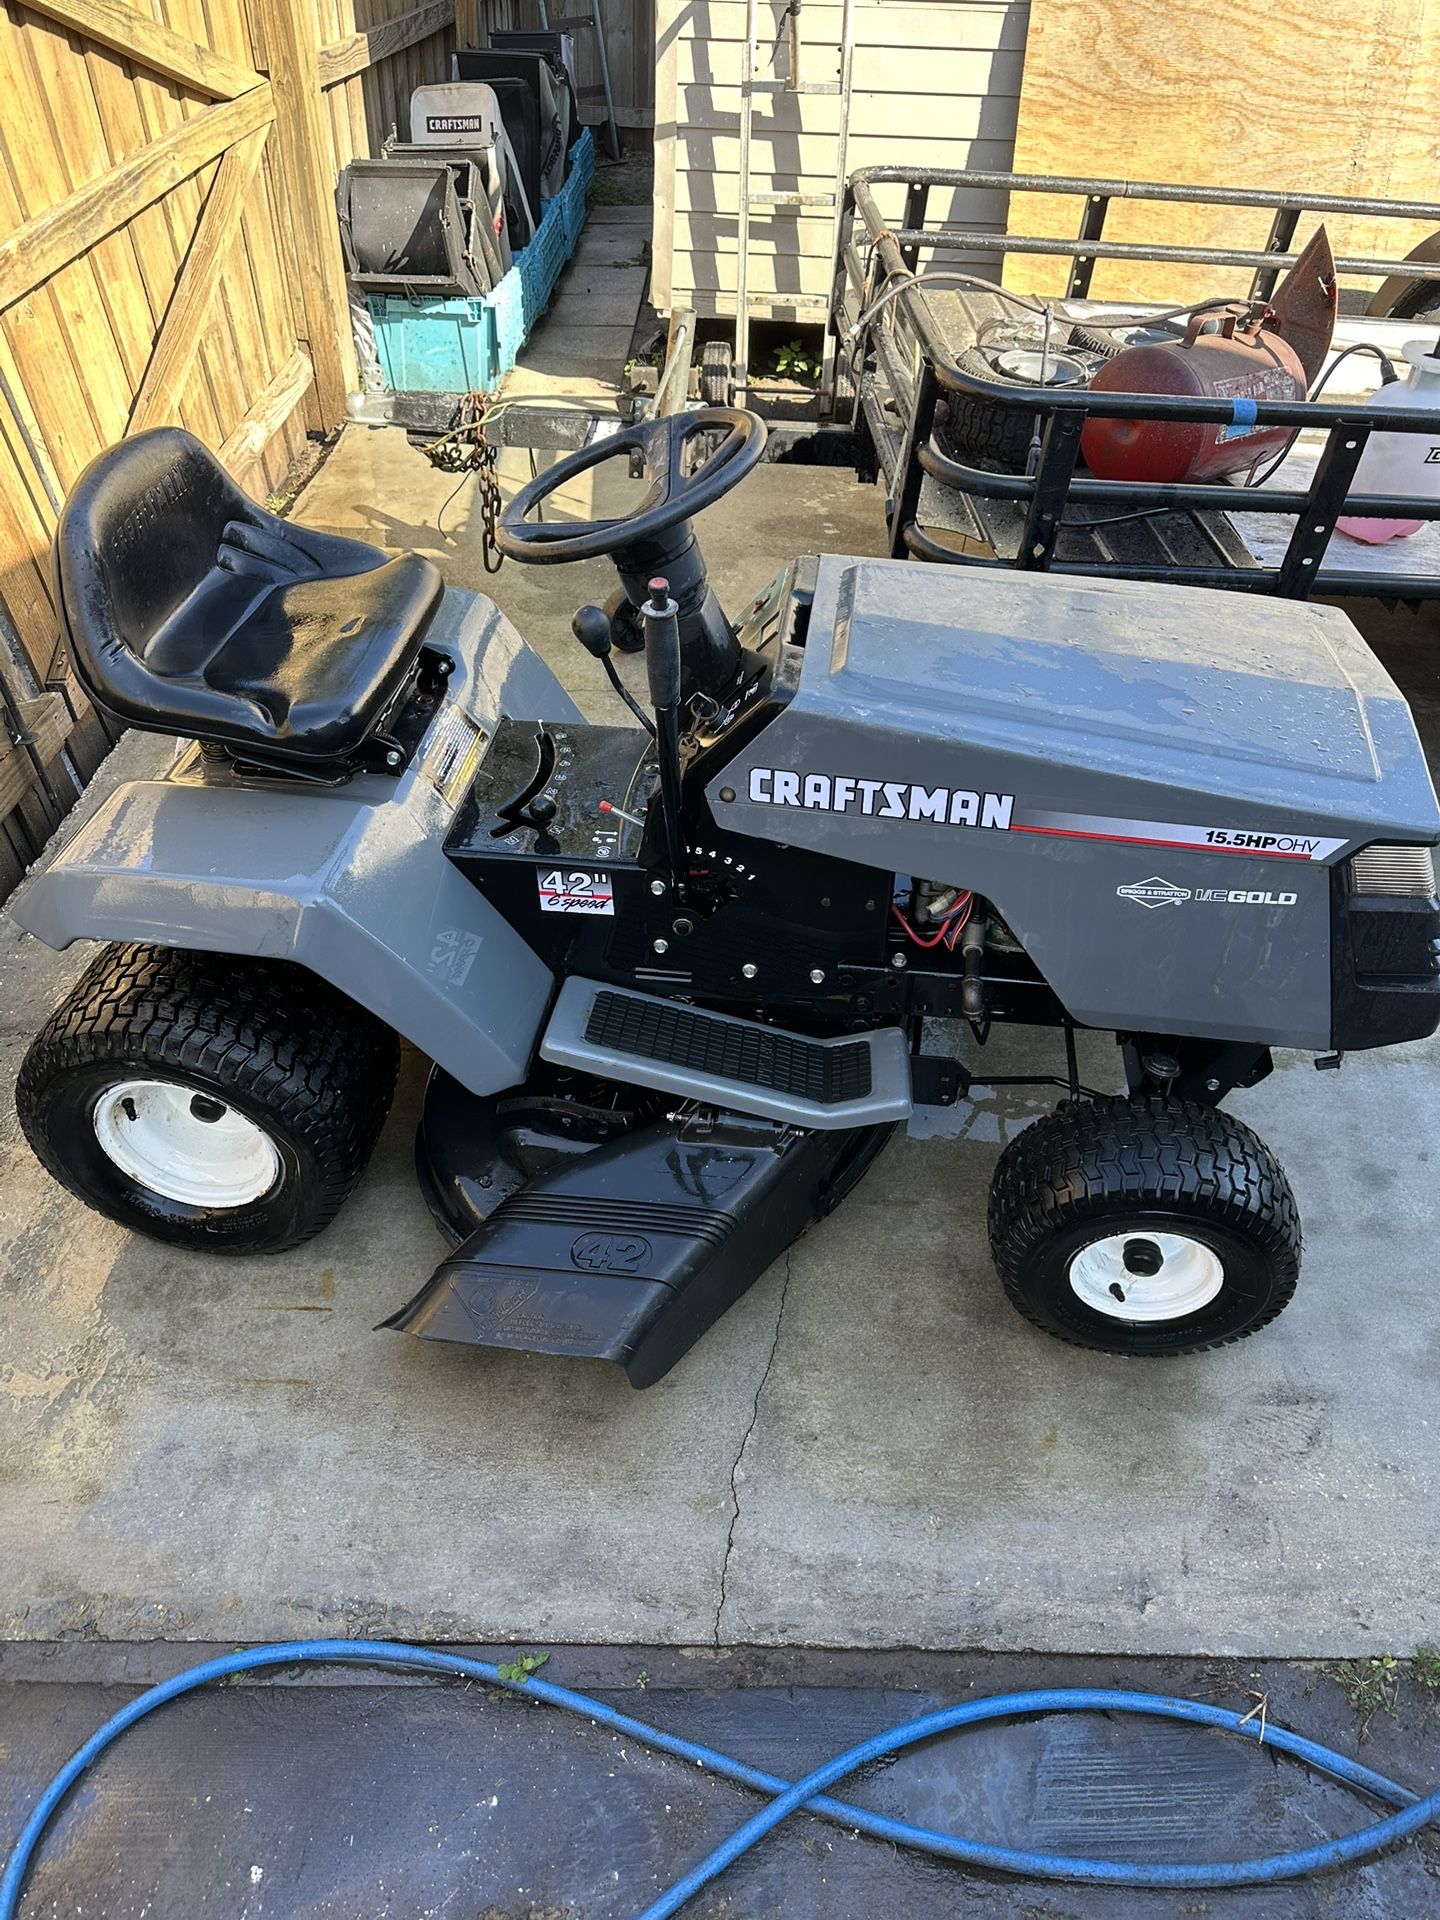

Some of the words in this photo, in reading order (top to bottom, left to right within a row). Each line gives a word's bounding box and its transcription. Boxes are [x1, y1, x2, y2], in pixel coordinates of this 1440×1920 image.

[429, 118, 480, 130] CRAFTSMAN
[749, 767, 1016, 830] CRAFTSMAN
[695, 846, 703, 855] 5
[708, 850, 717, 859] 4
[723, 856, 733, 865] 3
[735, 864, 746, 873] 2
[541, 869, 608, 898] 42"
[547, 894, 560, 906] 6
[561, 897, 613, 912] speed
[576, 1237, 647, 1273] 42
